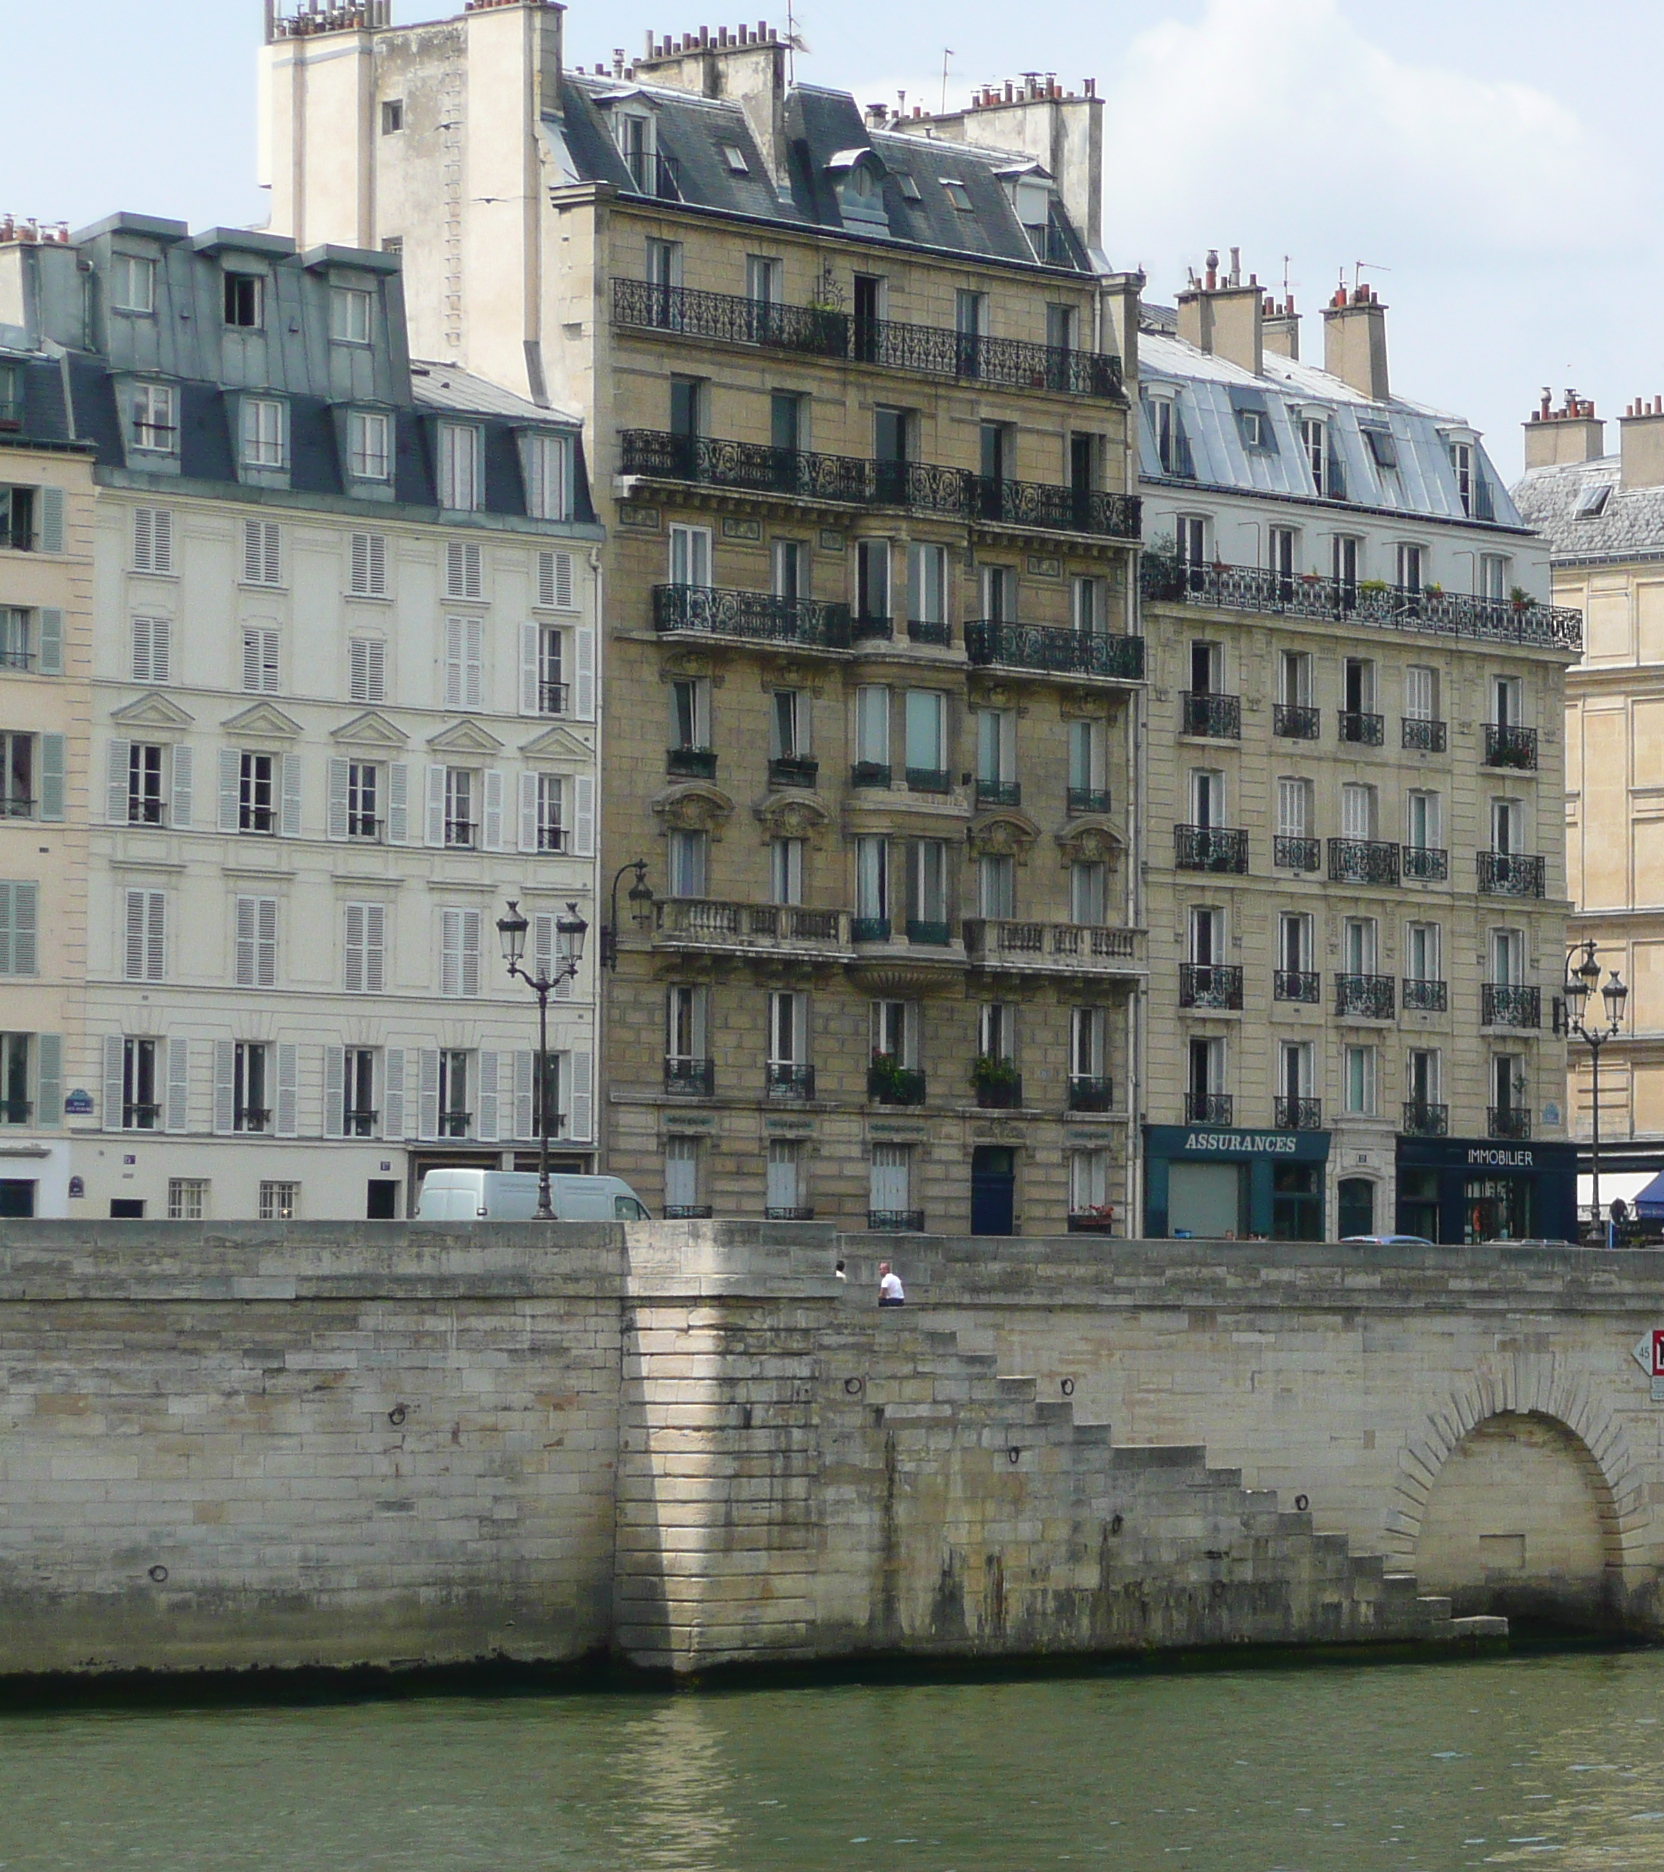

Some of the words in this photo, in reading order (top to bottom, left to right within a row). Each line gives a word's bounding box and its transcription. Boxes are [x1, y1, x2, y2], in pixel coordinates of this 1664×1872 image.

[1185, 1133, 1296, 1152] ASSURANCES
[1468, 1149, 1533, 1166] IMMOBILIER
[1639, 1346, 1650, 1359] 45
